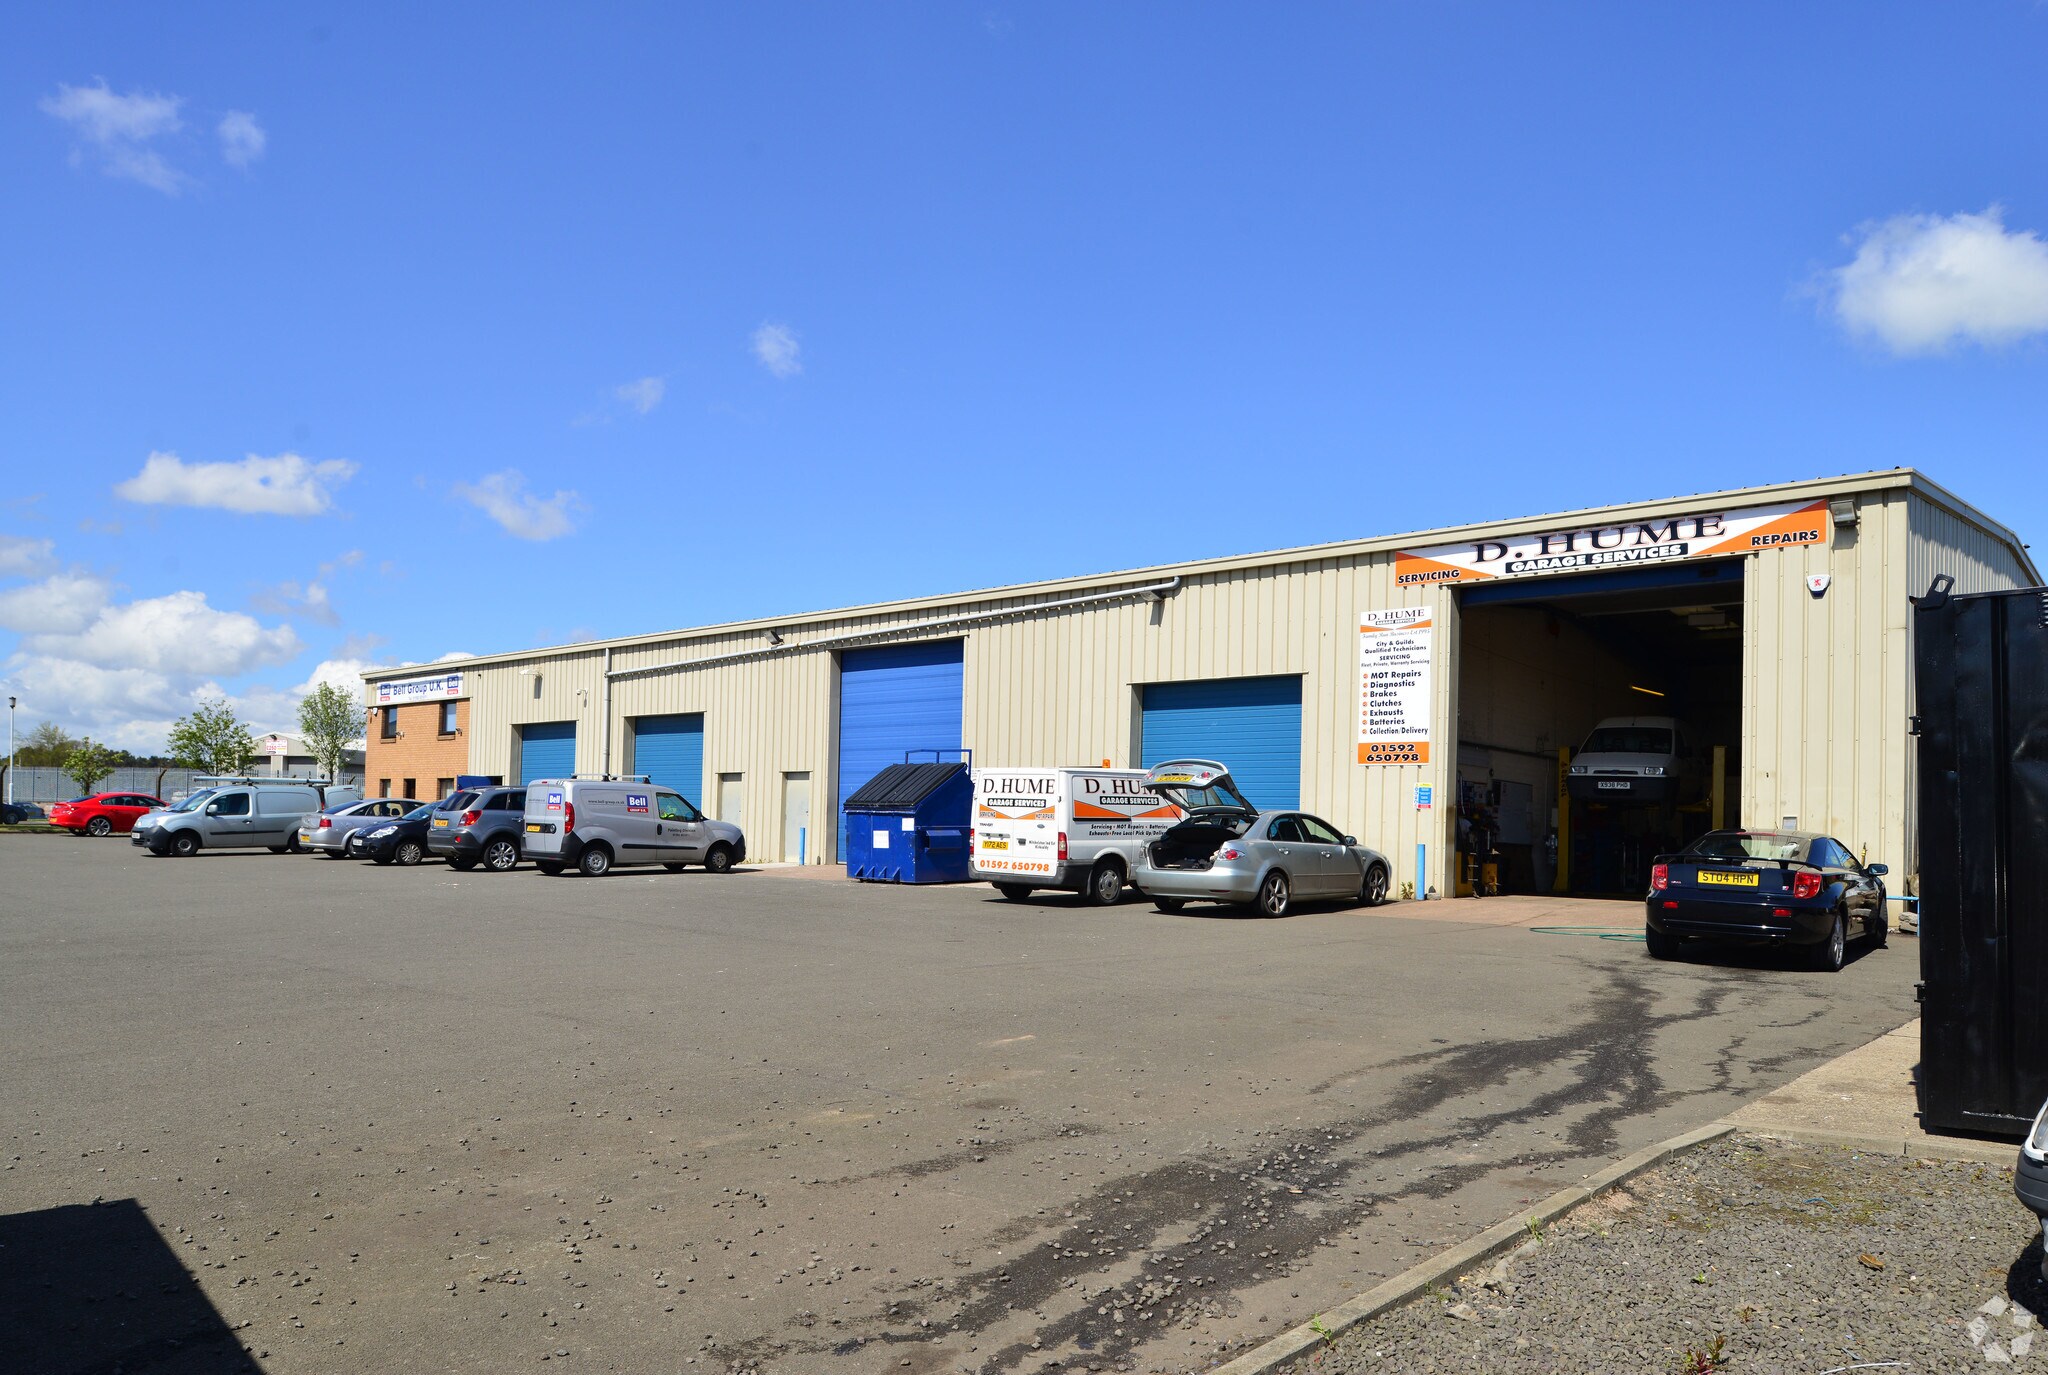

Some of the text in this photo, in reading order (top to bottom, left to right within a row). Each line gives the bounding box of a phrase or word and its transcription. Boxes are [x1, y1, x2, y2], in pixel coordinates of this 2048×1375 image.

[1473, 514, 1727, 565] D. HUME
[1751, 529, 1819, 547] REPAIRS
[1511, 545, 1682, 574] GARAGE SERVICES
[1398, 568, 1461, 585] SERVICING
[1368, 609, 1424, 621] D. HUME
[1364, 646, 1391, 654] Qualified
[1391, 670, 1422, 679] Repairs
[393, 685, 406, 695] Bell
[407, 684, 427, 695] Group
[429, 681, 444, 692] U.K.
[1370, 680, 1415, 689] Diagnostics
[1370, 690, 1397, 698] Brakes
[1369, 709, 1404, 717] Exhausts
[1369, 718, 1405, 726] Batteries
[1371, 744, 1415, 752] 01592
[1366, 753, 1419, 762] 650798
[1001, 778, 1055, 794] HUME
[1084, 778, 1106, 794] D.
[549, 795, 560, 804] Bell
[629, 796, 646, 806] Bell
[988, 798, 1045, 807] GARAGE SERVICES
[1130, 797, 1158, 805] SERVICES
[980, 860, 1050, 872] 01592 650798
[1702, 872, 1754, 885] ST04 HPN
